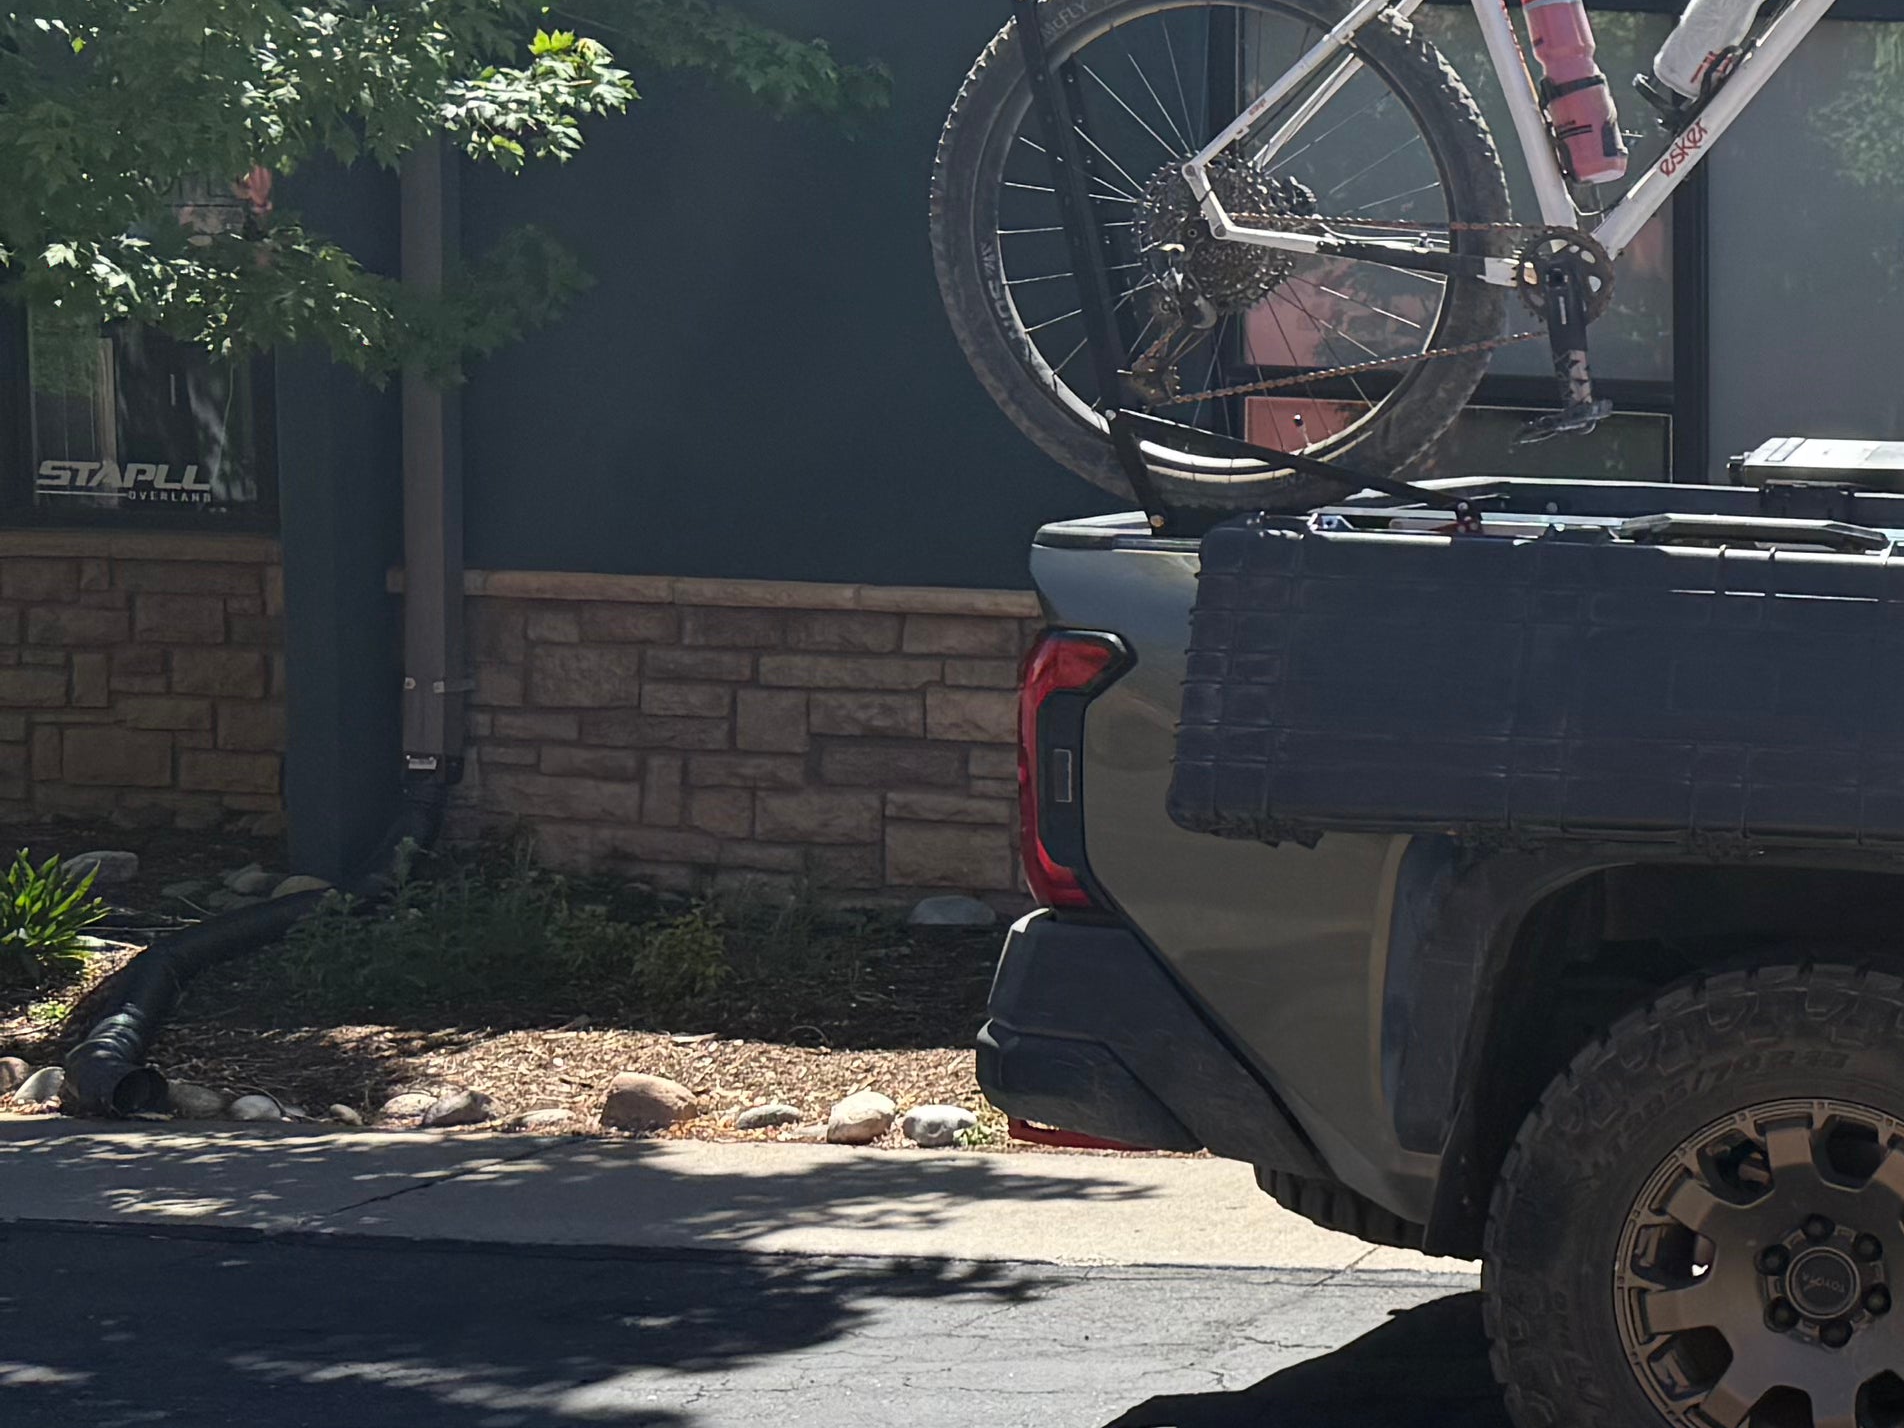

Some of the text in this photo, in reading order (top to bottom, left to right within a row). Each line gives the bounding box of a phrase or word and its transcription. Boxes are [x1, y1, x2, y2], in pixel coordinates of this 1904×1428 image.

[1659, 117, 1709, 178] esker
[36, 459, 211, 491] STAPLL
[127, 490, 213, 504] OVERLAND
